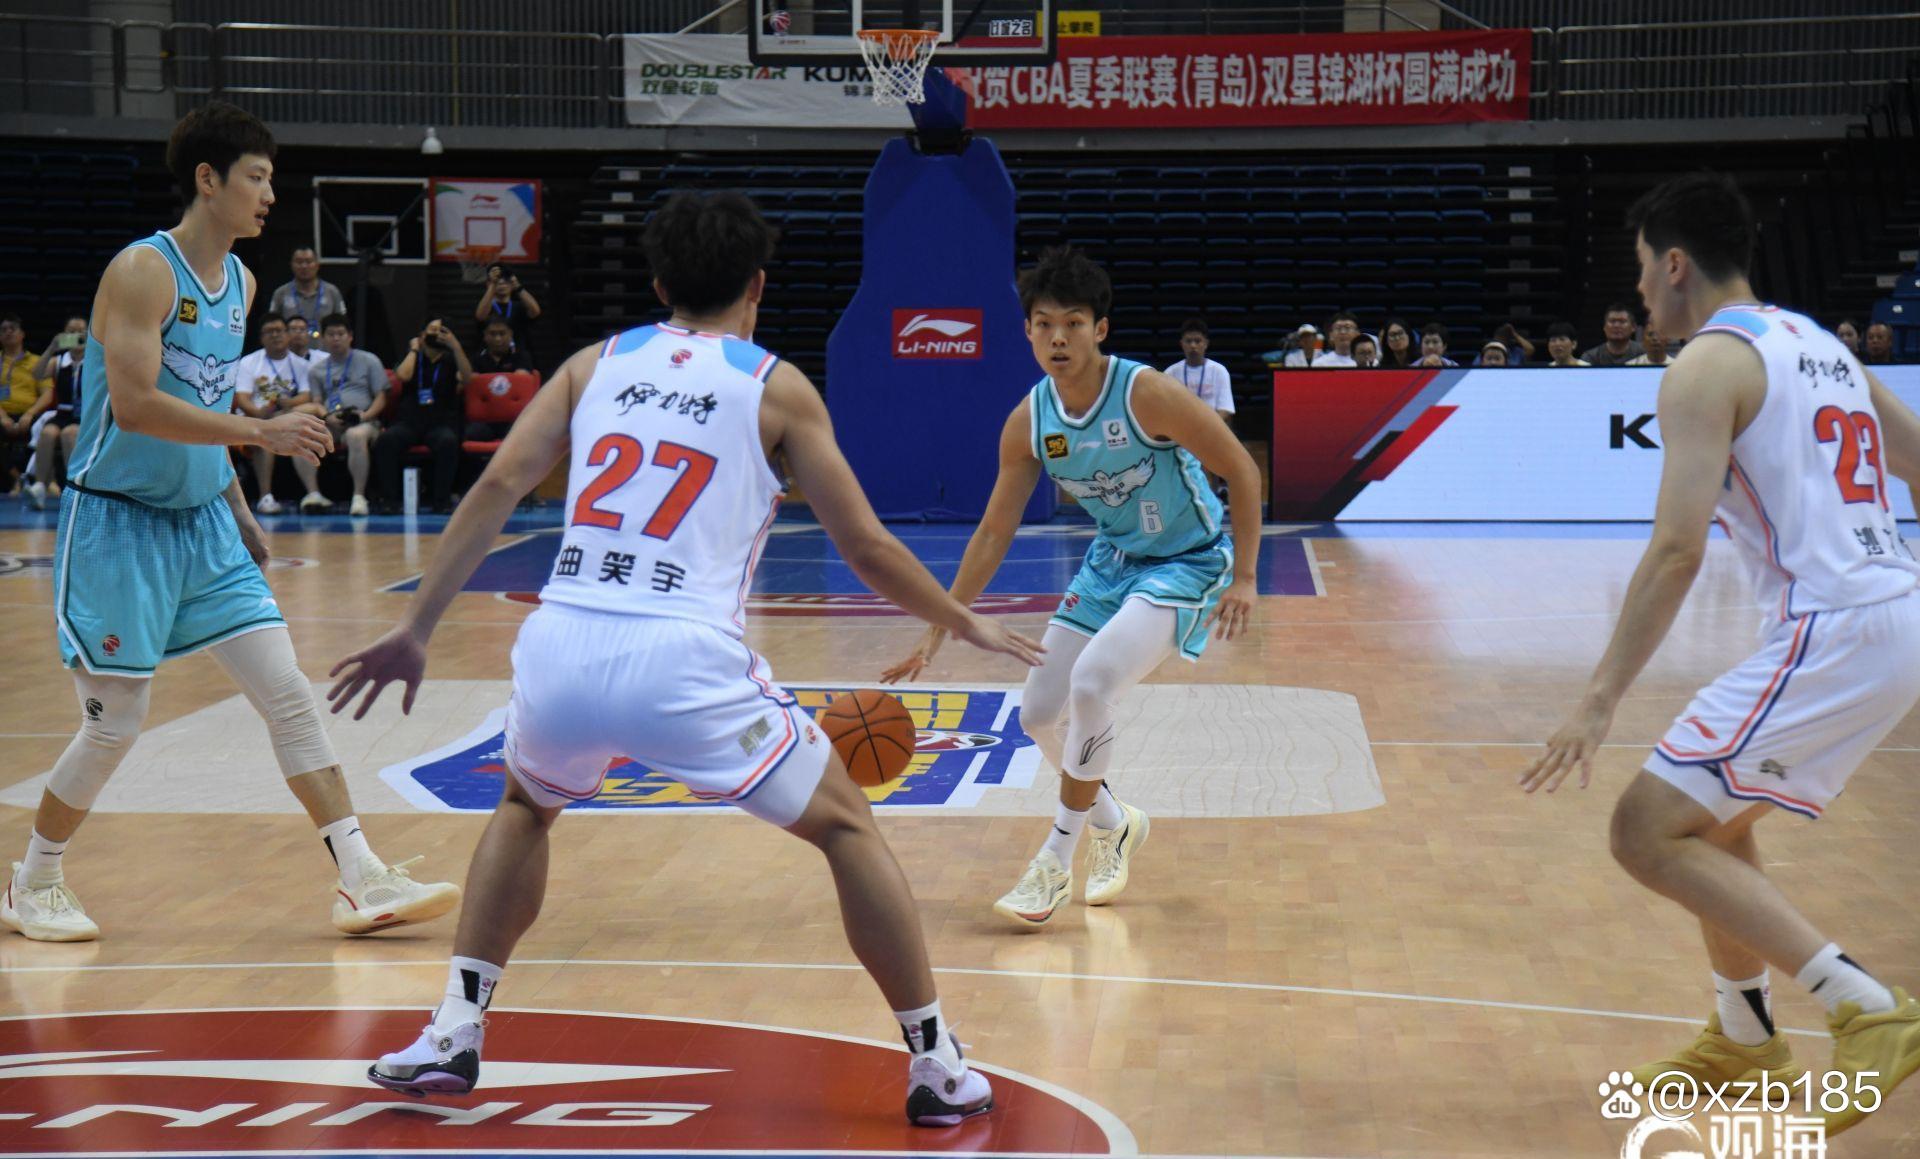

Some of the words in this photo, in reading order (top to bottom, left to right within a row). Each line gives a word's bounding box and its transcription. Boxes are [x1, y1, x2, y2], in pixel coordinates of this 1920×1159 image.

[640, 64, 786, 80] DOUBLESTAR
[804, 66, 875, 82] KUM
[898, 341, 976, 354] LI-NING
[1812, 404, 1890, 514] 23
[571, 432, 719, 542] 27
[1140, 501, 1164, 534] 6
[555, 545, 686, 593] 曲笑宇
